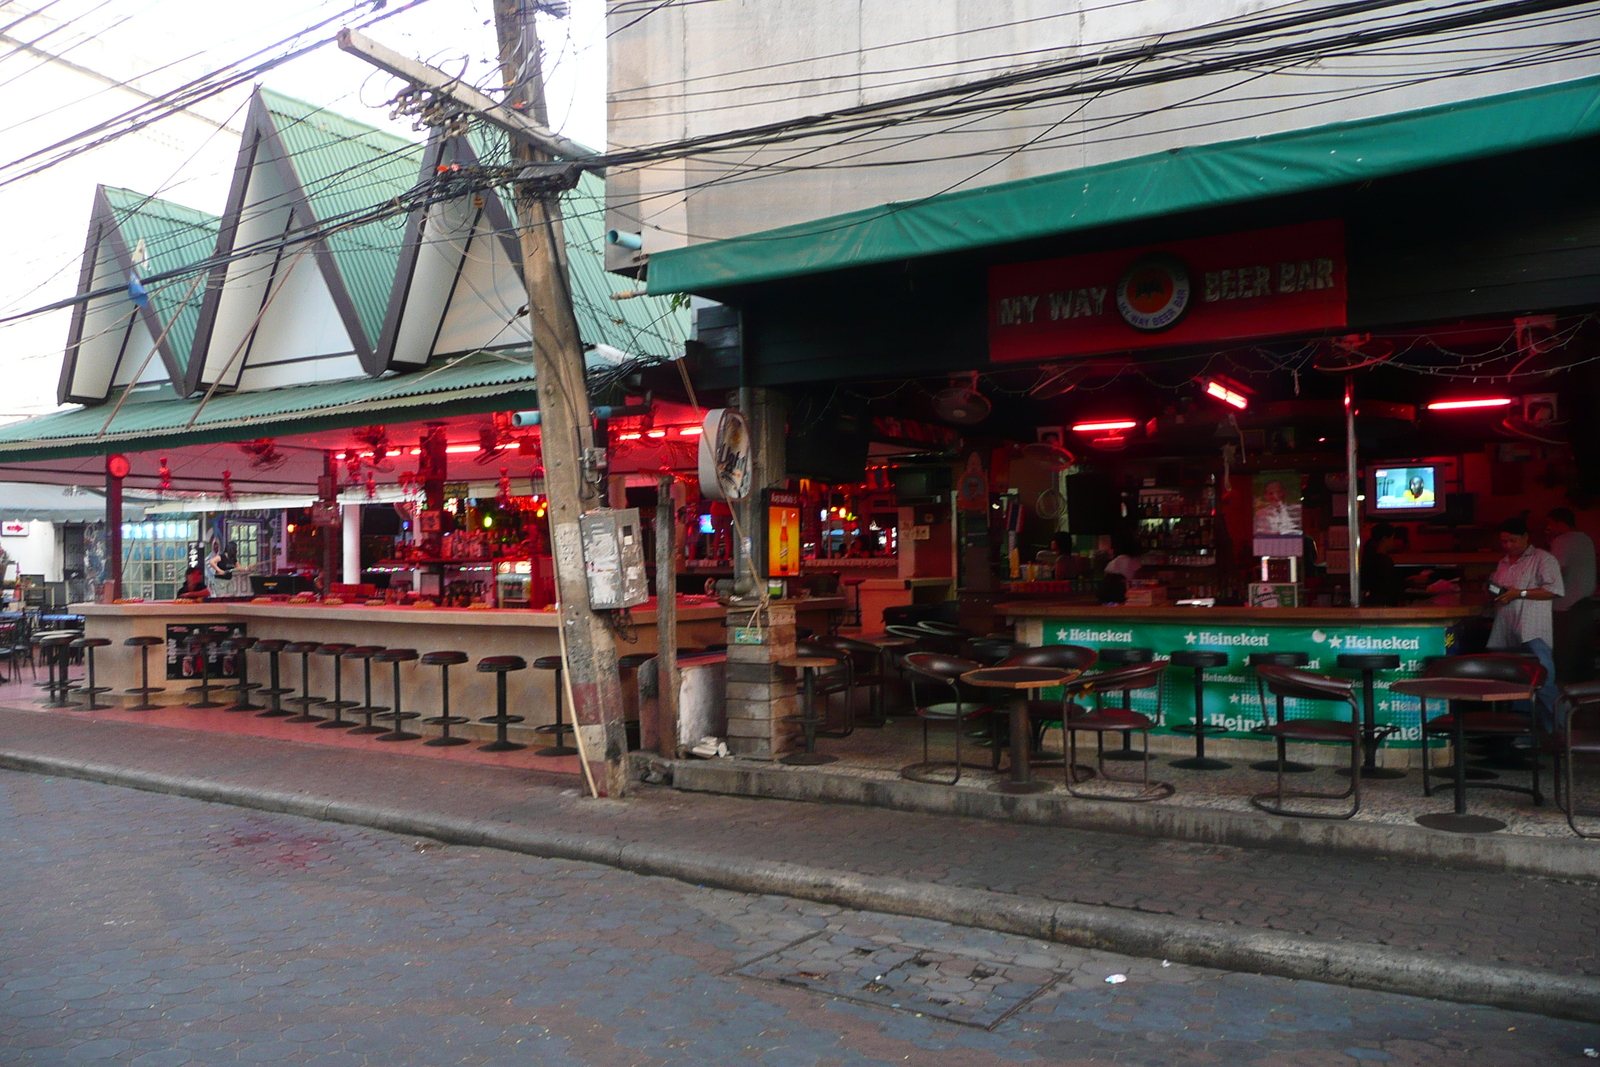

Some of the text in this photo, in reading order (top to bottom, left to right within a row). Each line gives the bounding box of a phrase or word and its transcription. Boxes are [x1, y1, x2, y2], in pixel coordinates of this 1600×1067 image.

[999, 294, 1040, 326] MY
[1048, 286, 1108, 321] WAY
[1203, 265, 1272, 303] BEER
[1278, 257, 1335, 293] BAR
[1119, 289, 1187, 327] MY WAY BEER BAR
[121, 524, 190, 539] TATTOO
[189, 542, 199, 568] TATT
[1069, 628, 1133, 643] Heineken
[1198, 632, 1270, 647] Heineken
[1344, 635, 1420, 650] Heineken
[1202, 673, 1246, 683] Heineken
[1107, 689, 1157, 699] Heieken
[1241, 693, 1297, 707] Heineen
